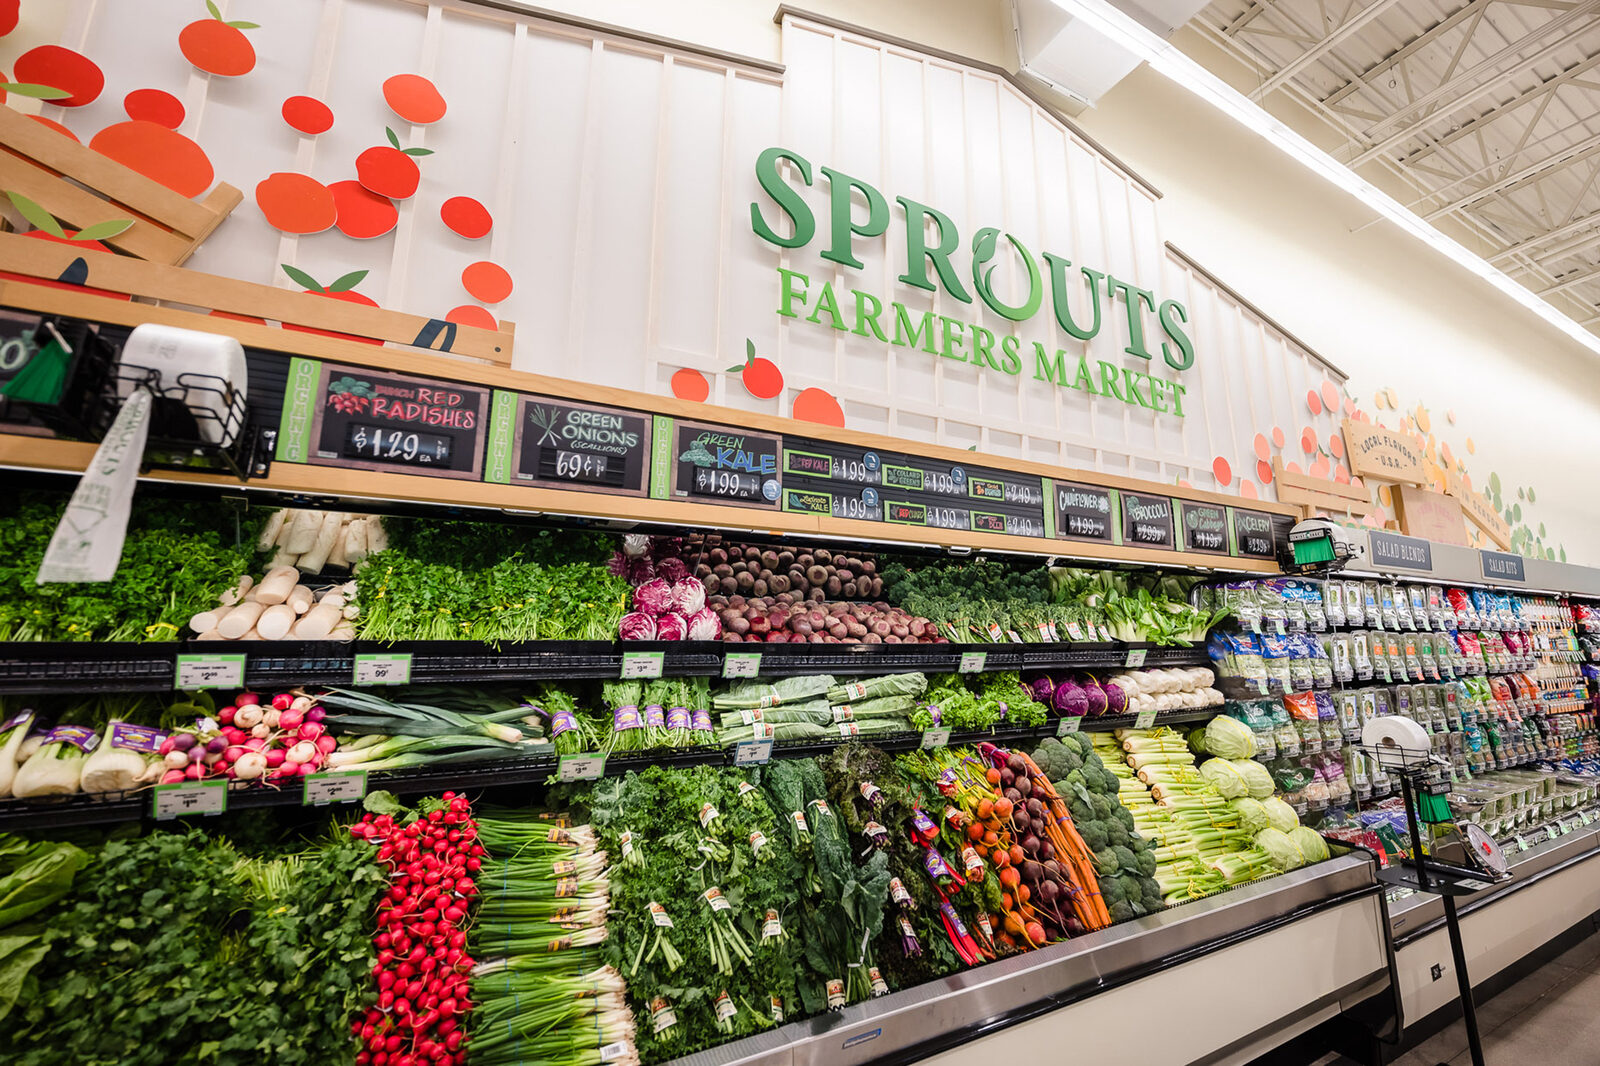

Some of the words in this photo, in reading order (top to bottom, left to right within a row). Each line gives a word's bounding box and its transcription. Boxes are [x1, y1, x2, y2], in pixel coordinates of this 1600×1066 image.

[750, 147, 1195, 371] SPROUTS
[775, 266, 1022, 376] FARMERS
[1032, 340, 1187, 418] MARKET
[417, 387, 462, 407] RED
[371, 397, 476, 429] RADISHES
[567, 410, 622, 430] GREEN
[354, 427, 419, 461] $1.29
[562, 425, 639, 447] ONIONS
[697, 431, 745, 449] GREEN
[570, 440, 628, 455] (SCALLIONS)
[1361, 435, 1382, 454] LOCAL
[1384, 436, 1417, 466] FLAVORS
[716, 446, 777, 475] KALE
[813, 460, 829, 472] KALE
[833, 459, 866, 482] $1.99
[698, 470, 740, 496] $1.99
[924, 473, 953, 493] $1.99
[1005, 485, 1030, 504] $2.49
[810, 502, 829, 512] KALE
[833, 497, 866, 519] $1.99
[1134, 503, 1168, 520] BROCCOLI
[928, 508, 956, 528] $1.99
[1007, 517, 1032, 536] $2.49
[1246, 516, 1270, 532] CELERY
[1376, 540, 1400, 559] SALAD
[1401, 545, 1426, 563] BLENDS
[1488, 558, 1505, 573] SALAD
[1506, 561, 1518, 575] KITS
